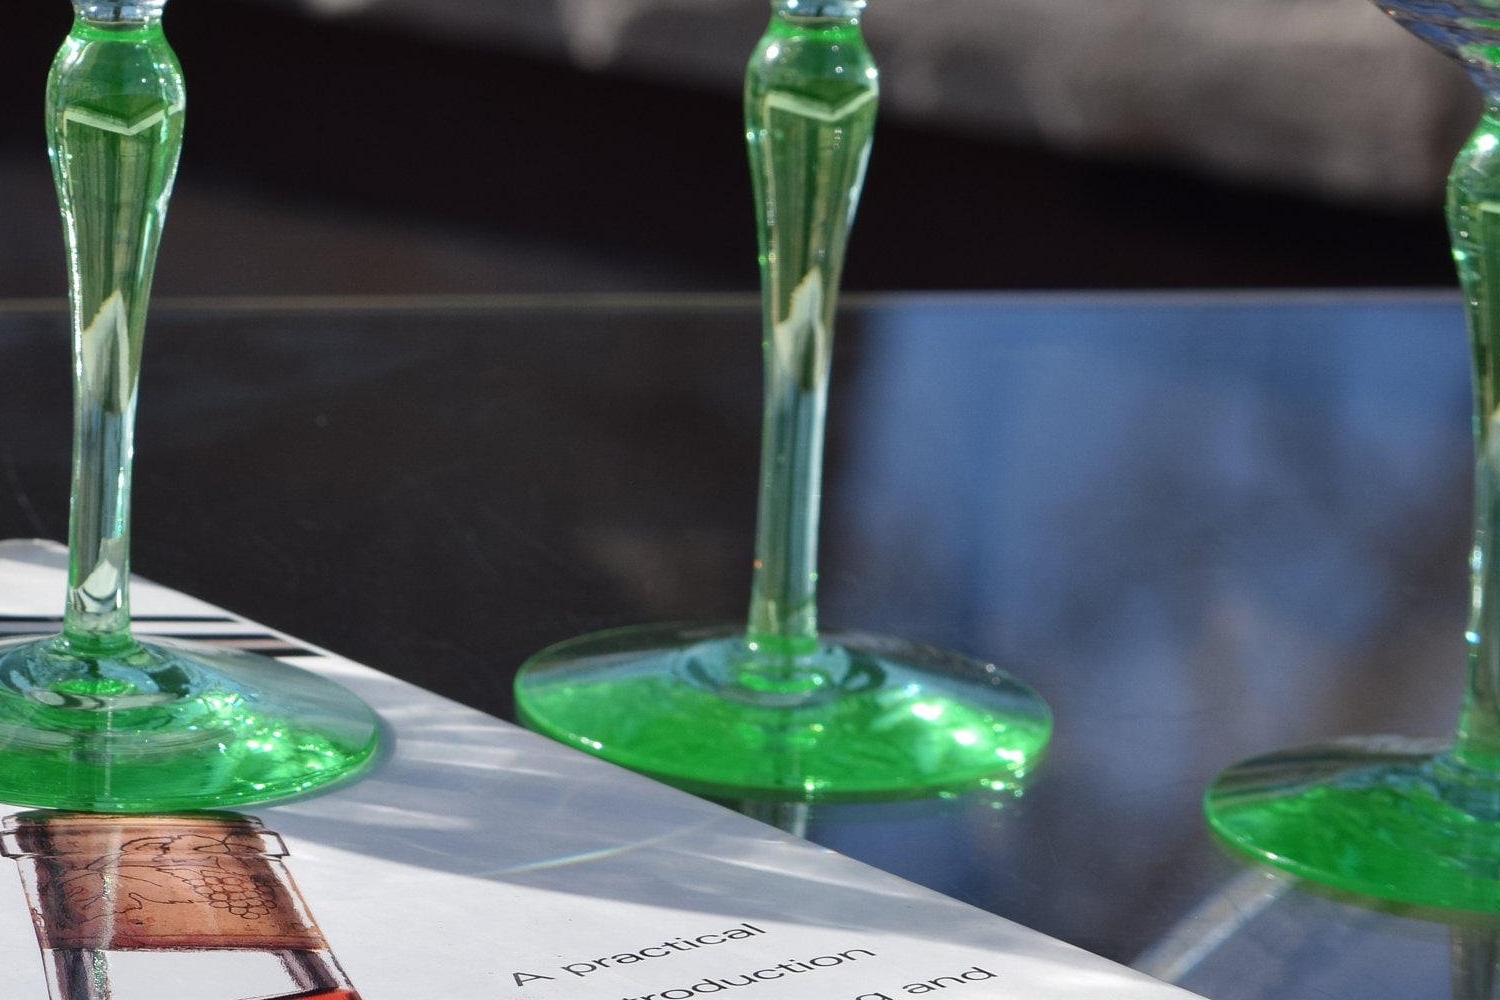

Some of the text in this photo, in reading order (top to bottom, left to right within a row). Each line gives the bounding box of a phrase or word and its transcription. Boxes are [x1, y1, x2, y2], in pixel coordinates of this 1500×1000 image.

[512, 923, 767, 987] A practical
[901, 966, 999, 994] and
